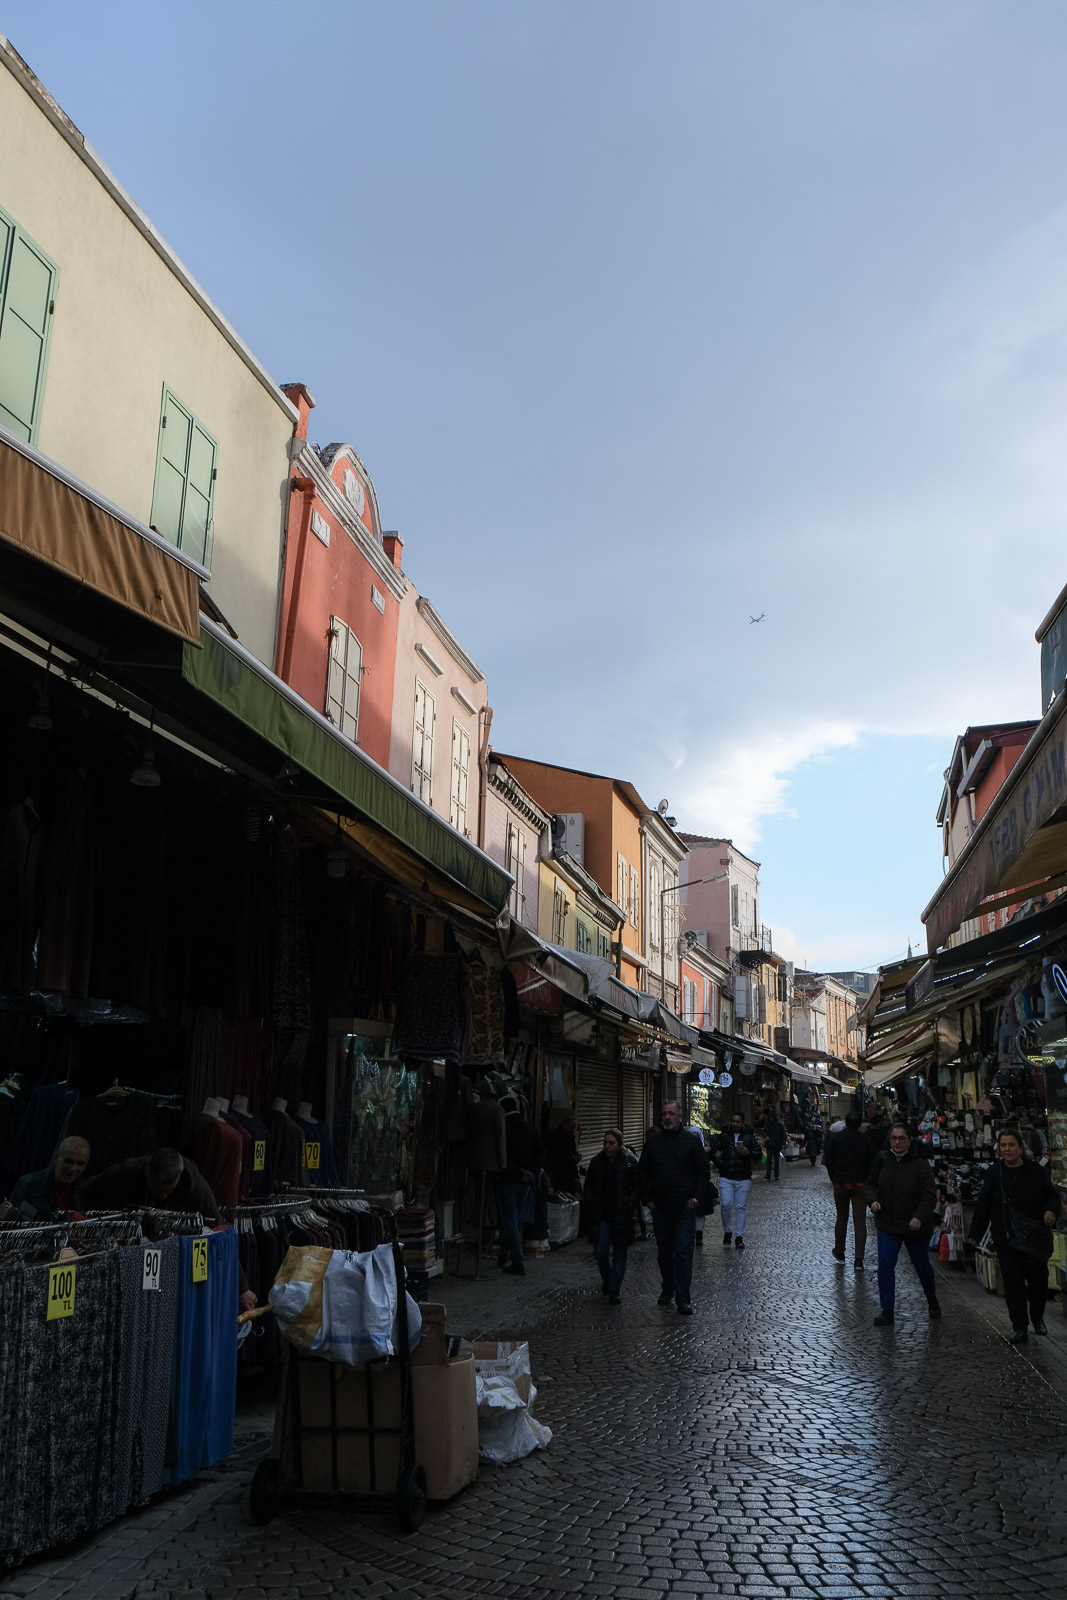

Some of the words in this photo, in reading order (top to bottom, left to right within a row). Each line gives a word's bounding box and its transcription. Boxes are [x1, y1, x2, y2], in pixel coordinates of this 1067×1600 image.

[256, 1143, 264, 1159] 60
[307, 1144, 319, 1160] 70
[194, 1242, 207, 1268] 75
[145, 1252, 159, 1277] 90
[201, 1267, 207, 1276] TL
[51, 1270, 73, 1301] 100
[151, 1278, 158, 1288] TL
[63, 1300, 72, 1311] TL
